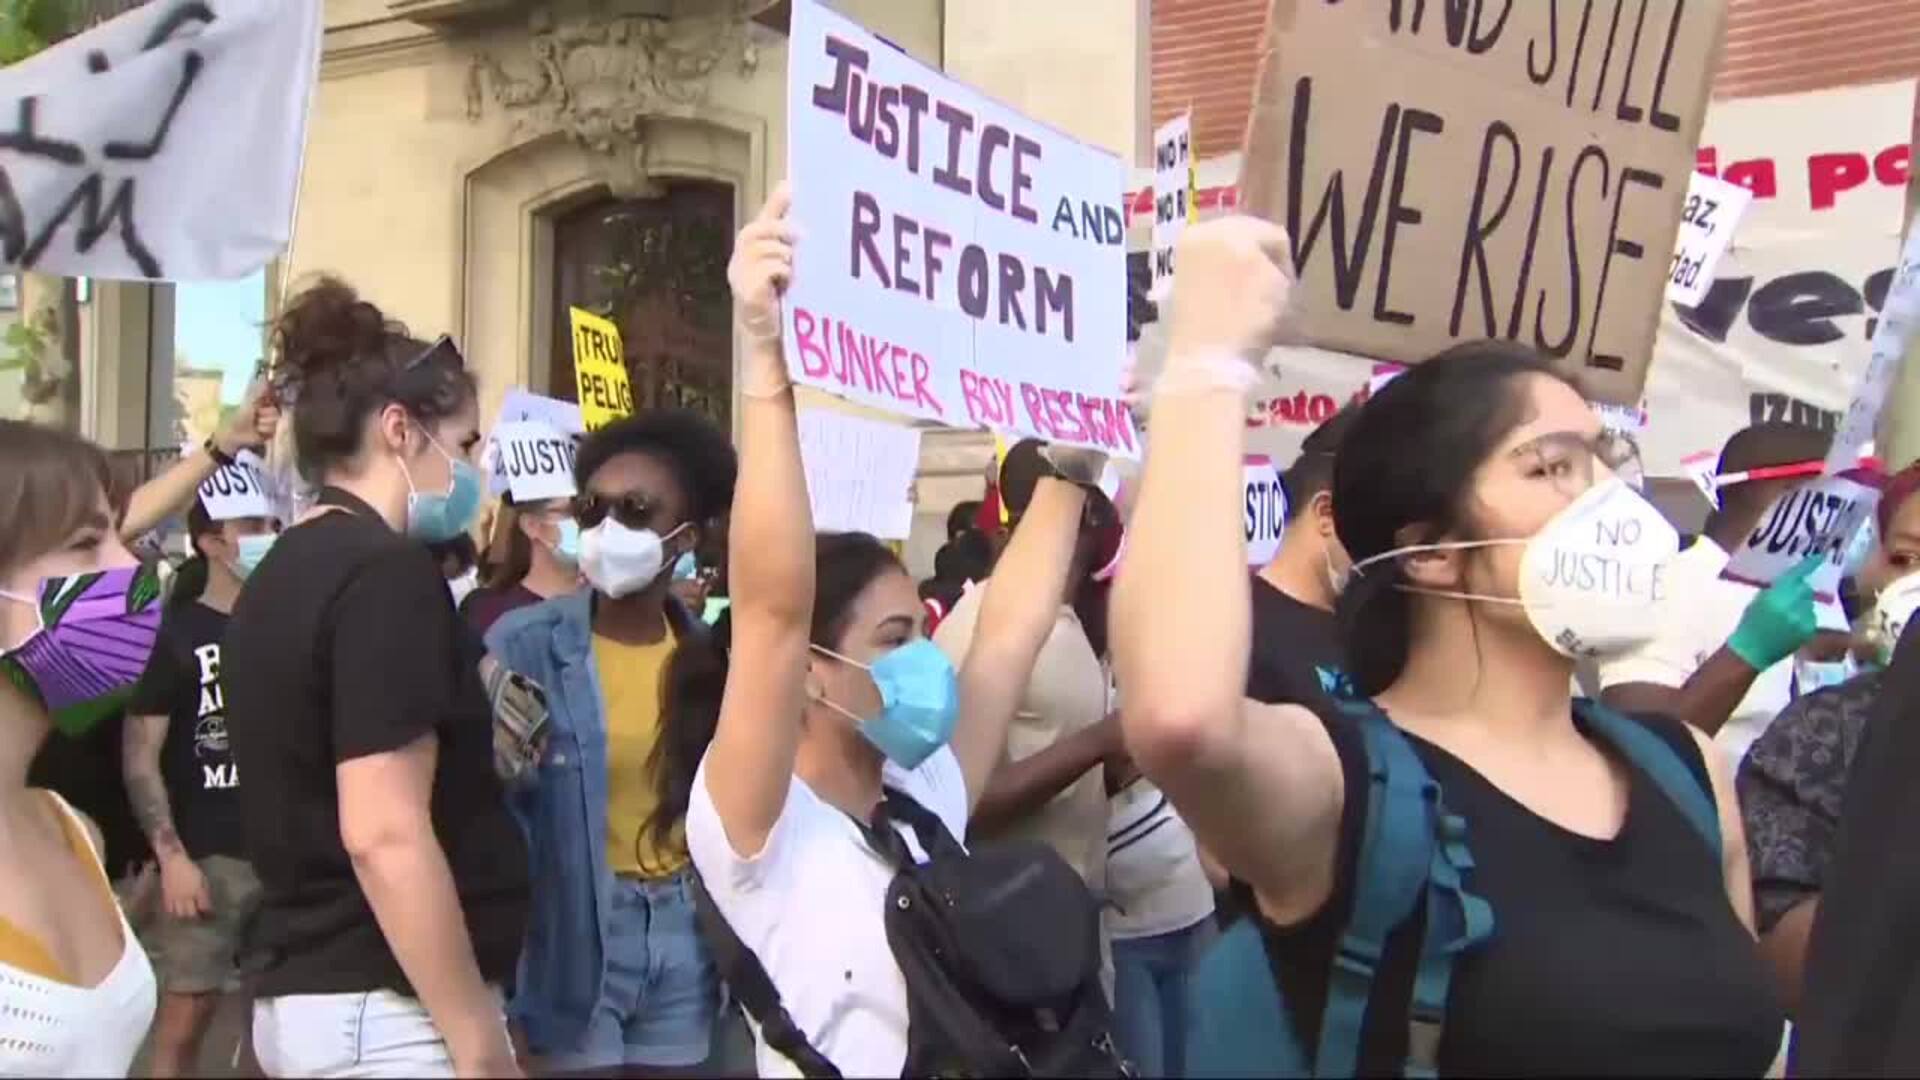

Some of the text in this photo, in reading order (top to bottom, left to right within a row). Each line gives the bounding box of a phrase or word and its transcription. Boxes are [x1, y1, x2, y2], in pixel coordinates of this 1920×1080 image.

[813, 35, 1123, 246] JUSTICE AND
[850, 191, 1074, 343] REFORM
[1287, 76, 1664, 372] WE RISE
[793, 307, 1133, 452] BUNKER BOY RESIGN
[1541, 546, 1667, 602] JUSTICE
[1596, 517, 1642, 547] NO
